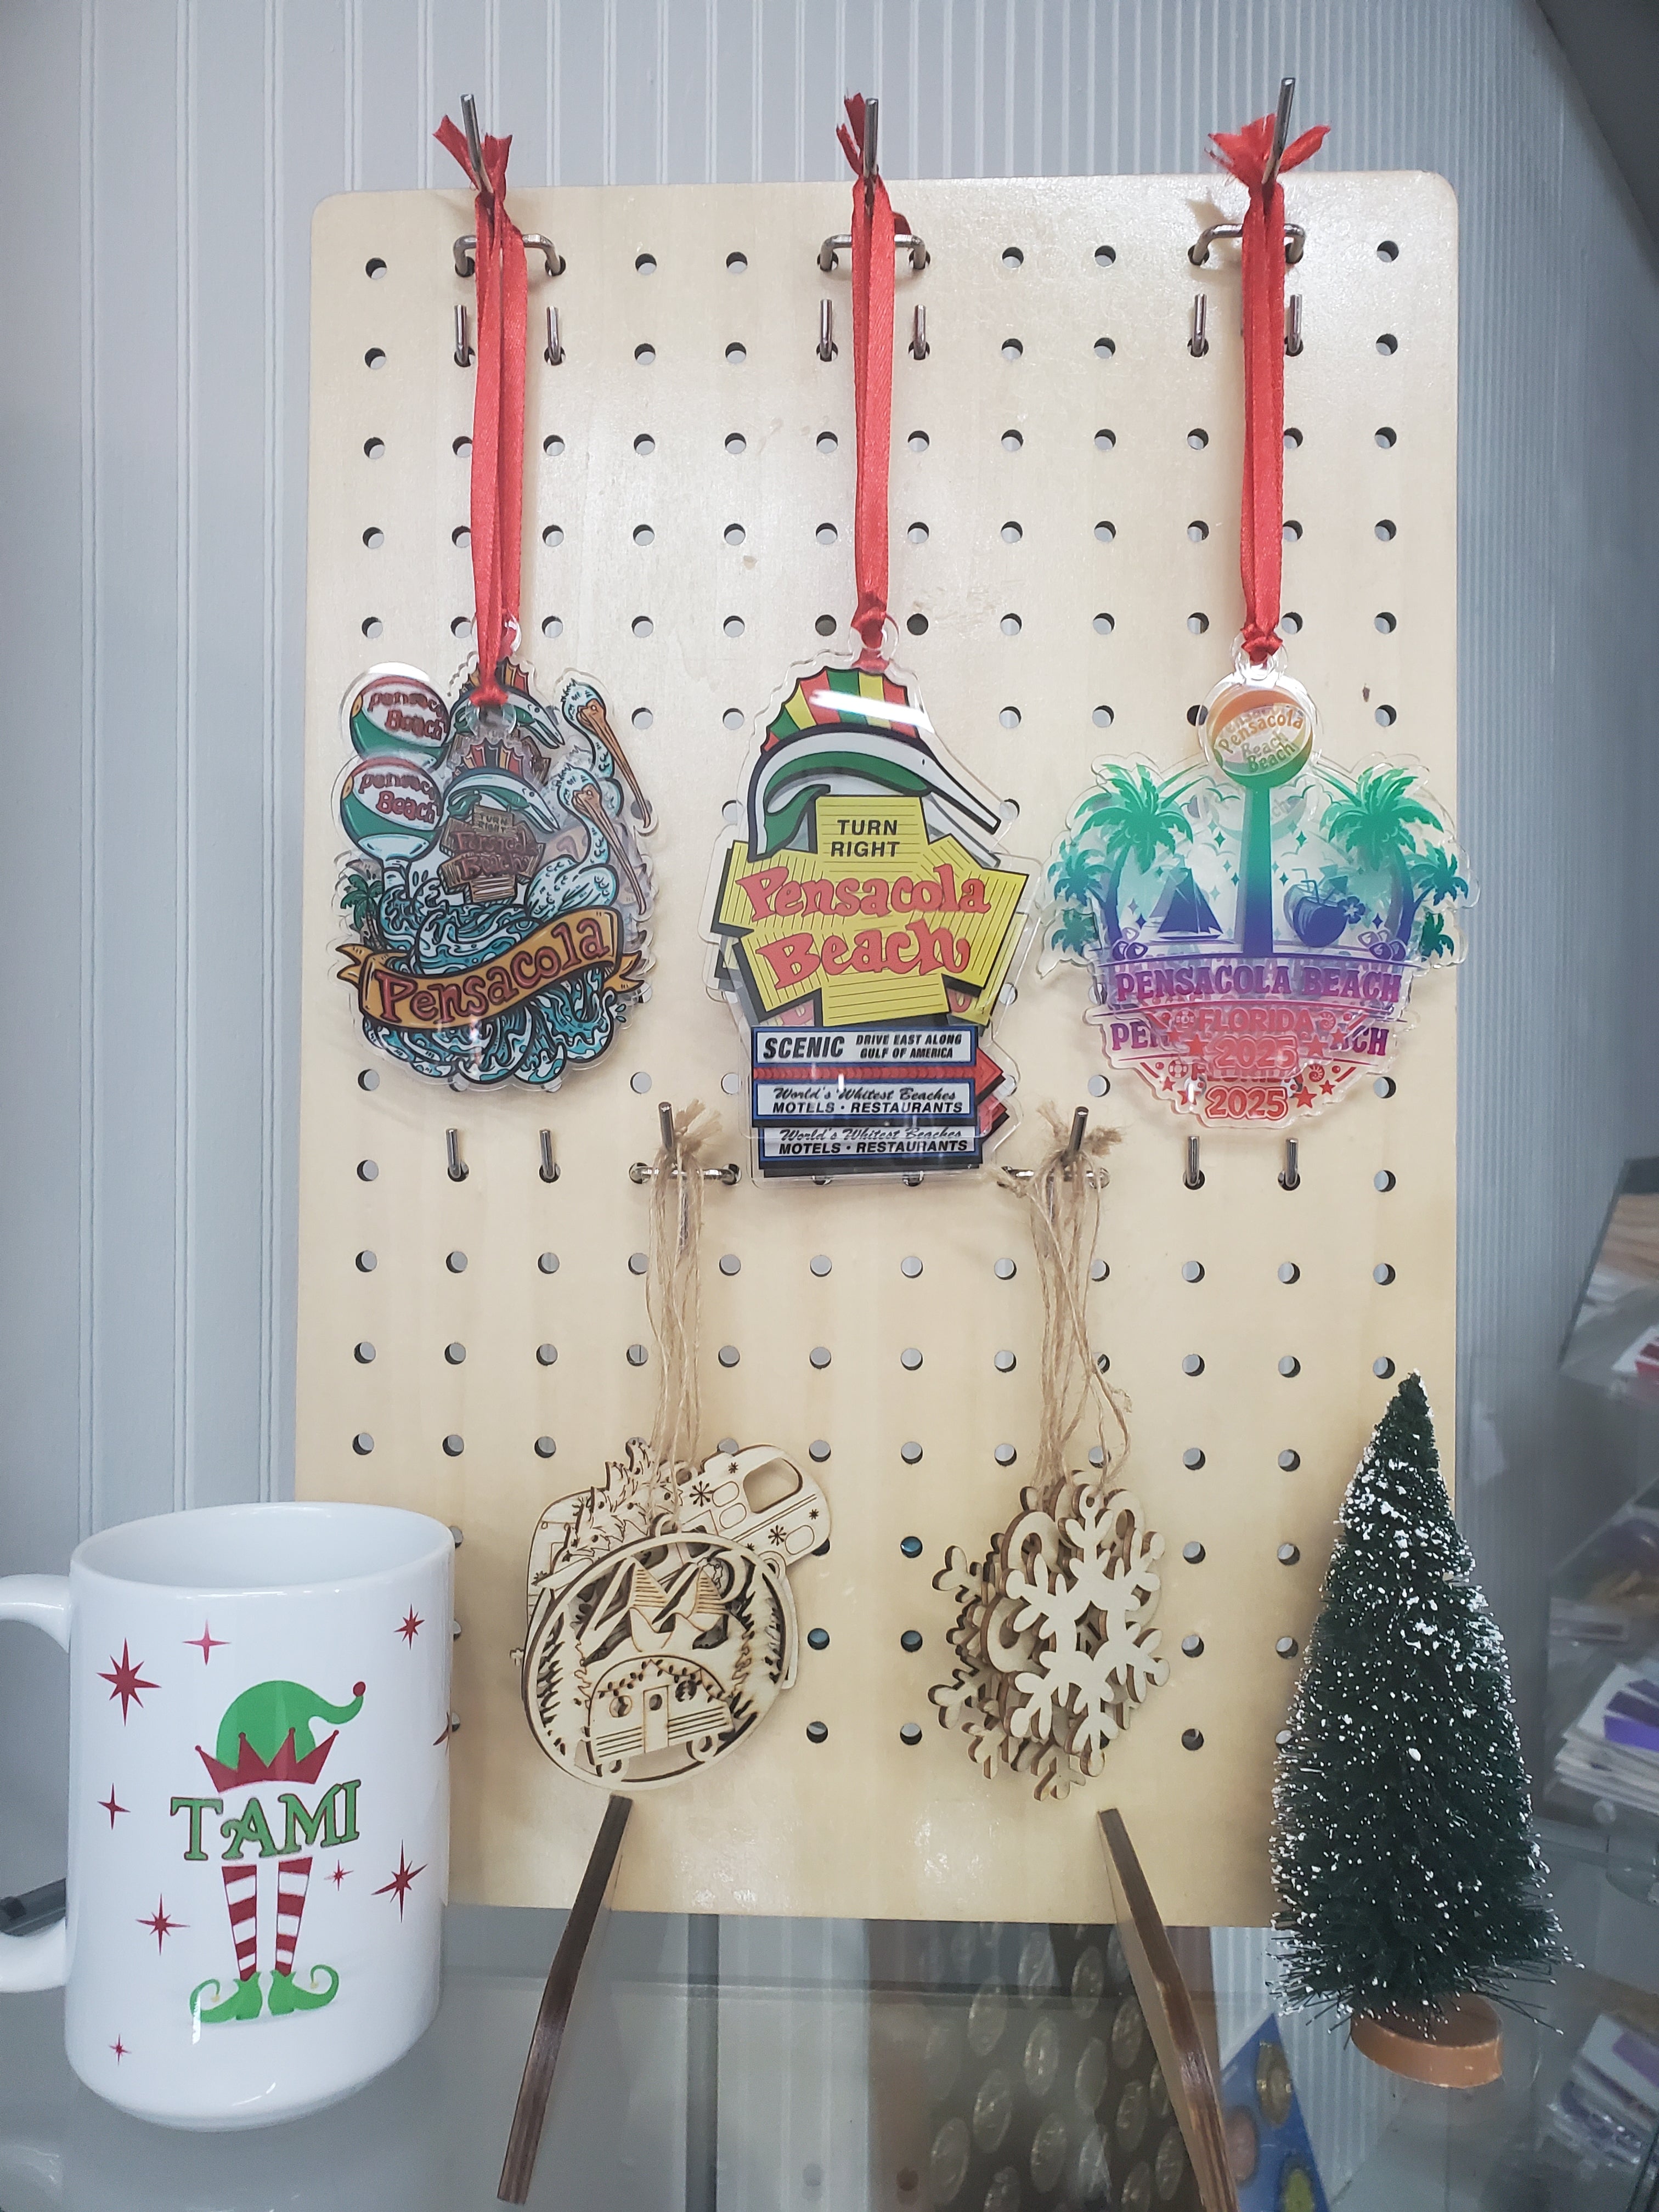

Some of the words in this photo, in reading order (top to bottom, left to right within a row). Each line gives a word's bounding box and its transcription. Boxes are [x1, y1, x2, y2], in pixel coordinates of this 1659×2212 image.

[1218, 709, 1304, 754] Pensacola
[375, 791, 441, 824] Beach
[837, 820, 898, 836] TURN
[830, 841, 900, 857] RIGHT
[736, 864, 991, 922] Pensacola
[756, 919, 970, 990] Beach
[374, 918, 611, 1023] Pensacola
[1116, 965, 1290, 1002] PENSACOLA
[1303, 967, 1402, 1002] BEACH
[1198, 1008, 1314, 1032] FLORIDA
[763, 1036, 845, 1059] SCENIC
[856, 1034, 889, 1046] DRIVE
[894, 1034, 922, 1045] EAST
[924, 1034, 962, 1045] ALONG
[860, 1047, 889, 1059] GULF
[892, 1047, 907, 1059] OF
[910, 1047, 953, 1058] AMERICA
[1215, 1036, 1297, 1069] 2025
[772, 1102, 835, 1113] MOTELS
[850, 1102, 962, 1113] RESTAURANTS
[774, 1087, 831, 1100] World's
[837, 1086, 894, 1100] Whitest
[899, 1087, 956, 1101] Beaches
[1205, 1085, 1288, 1121] 2025
[779, 1142, 840, 1154] MOTELS
[856, 1141, 967, 1153] RESTAURANTS
[780, 1128, 837, 1142] World's
[905, 1126, 962, 1139] Beaches
[170, 1779, 362, 1860] TAMI
